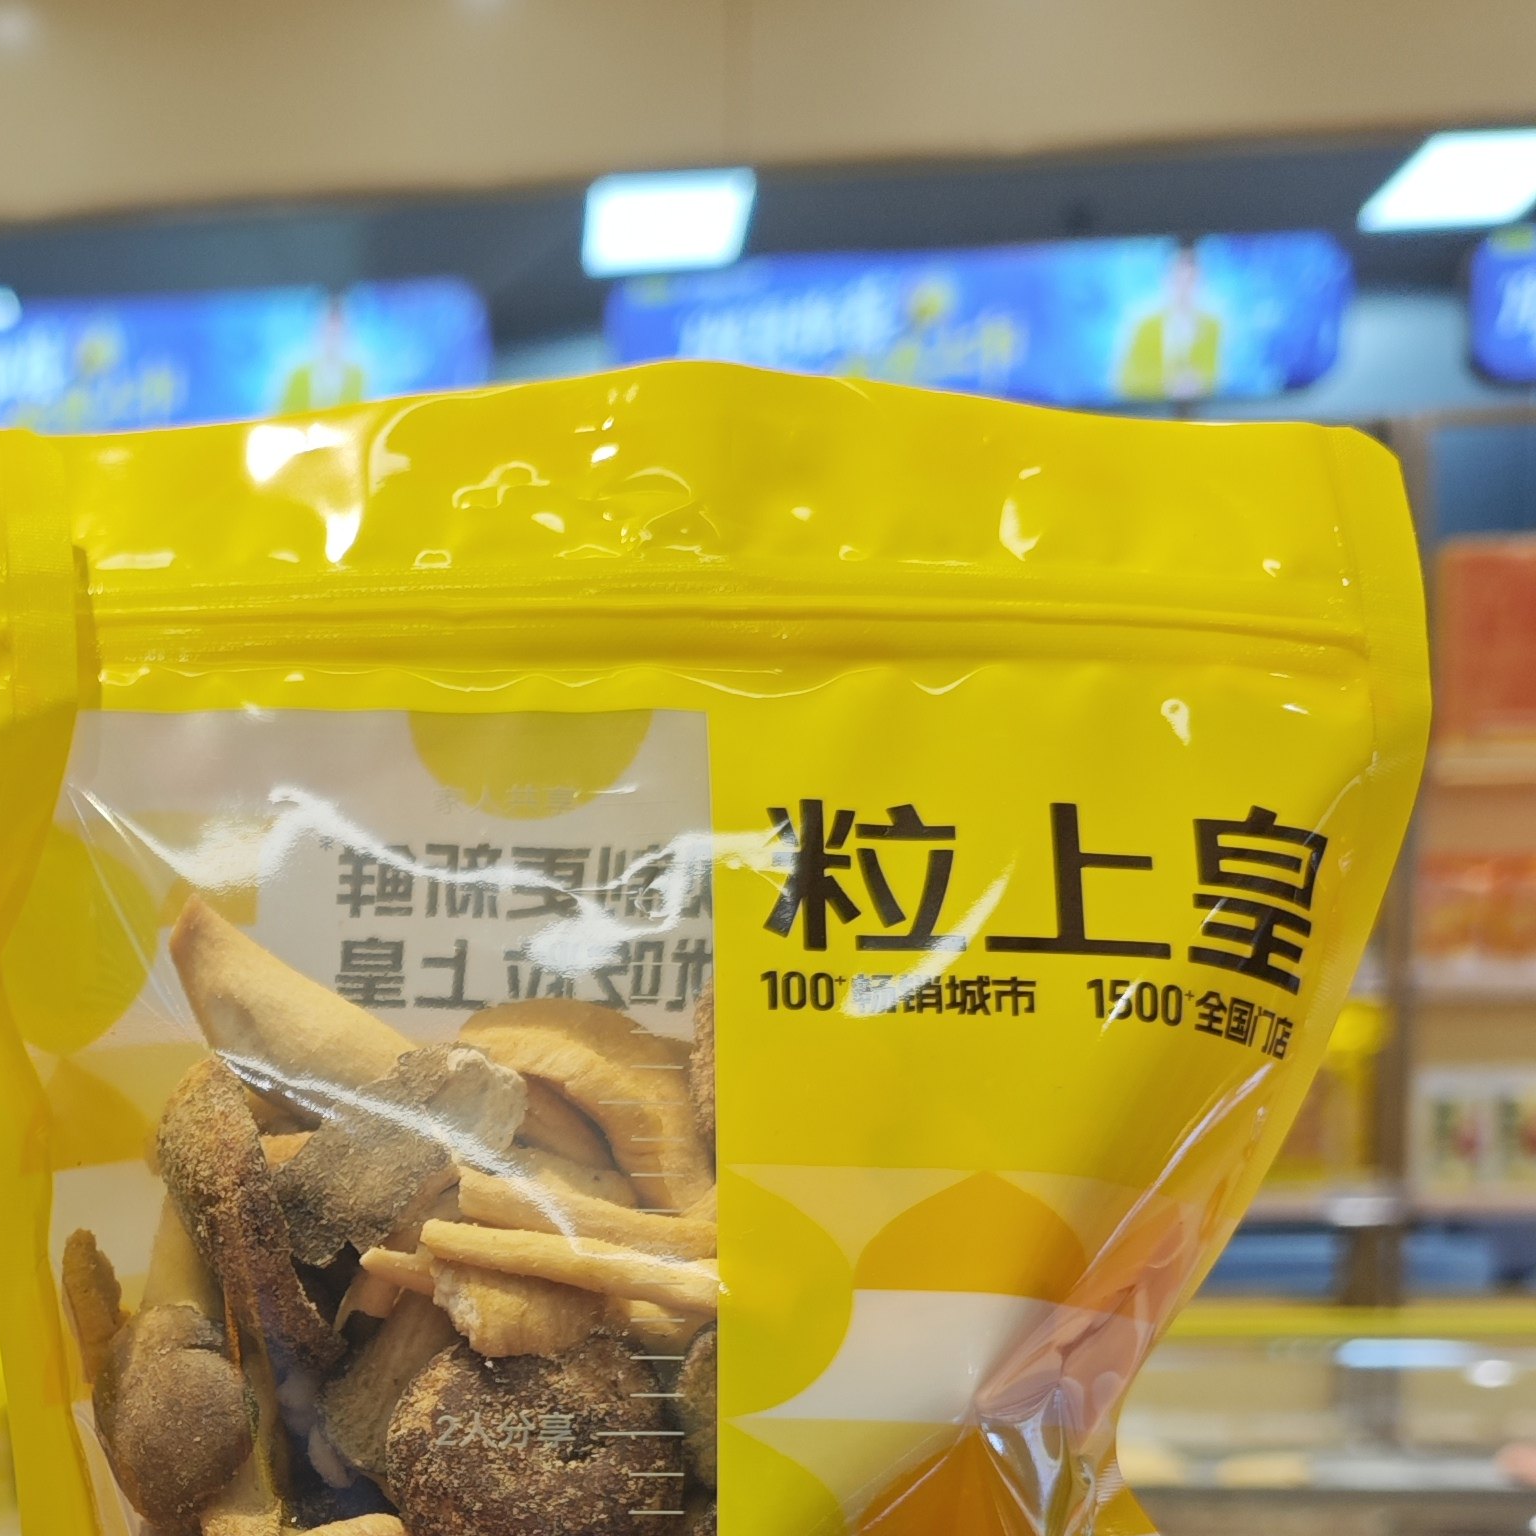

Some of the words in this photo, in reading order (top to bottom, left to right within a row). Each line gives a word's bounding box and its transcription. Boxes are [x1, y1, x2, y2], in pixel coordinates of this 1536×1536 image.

[764, 799, 1329, 995] 粒上皇
[436, 1412, 577, 1448] 2人分享
